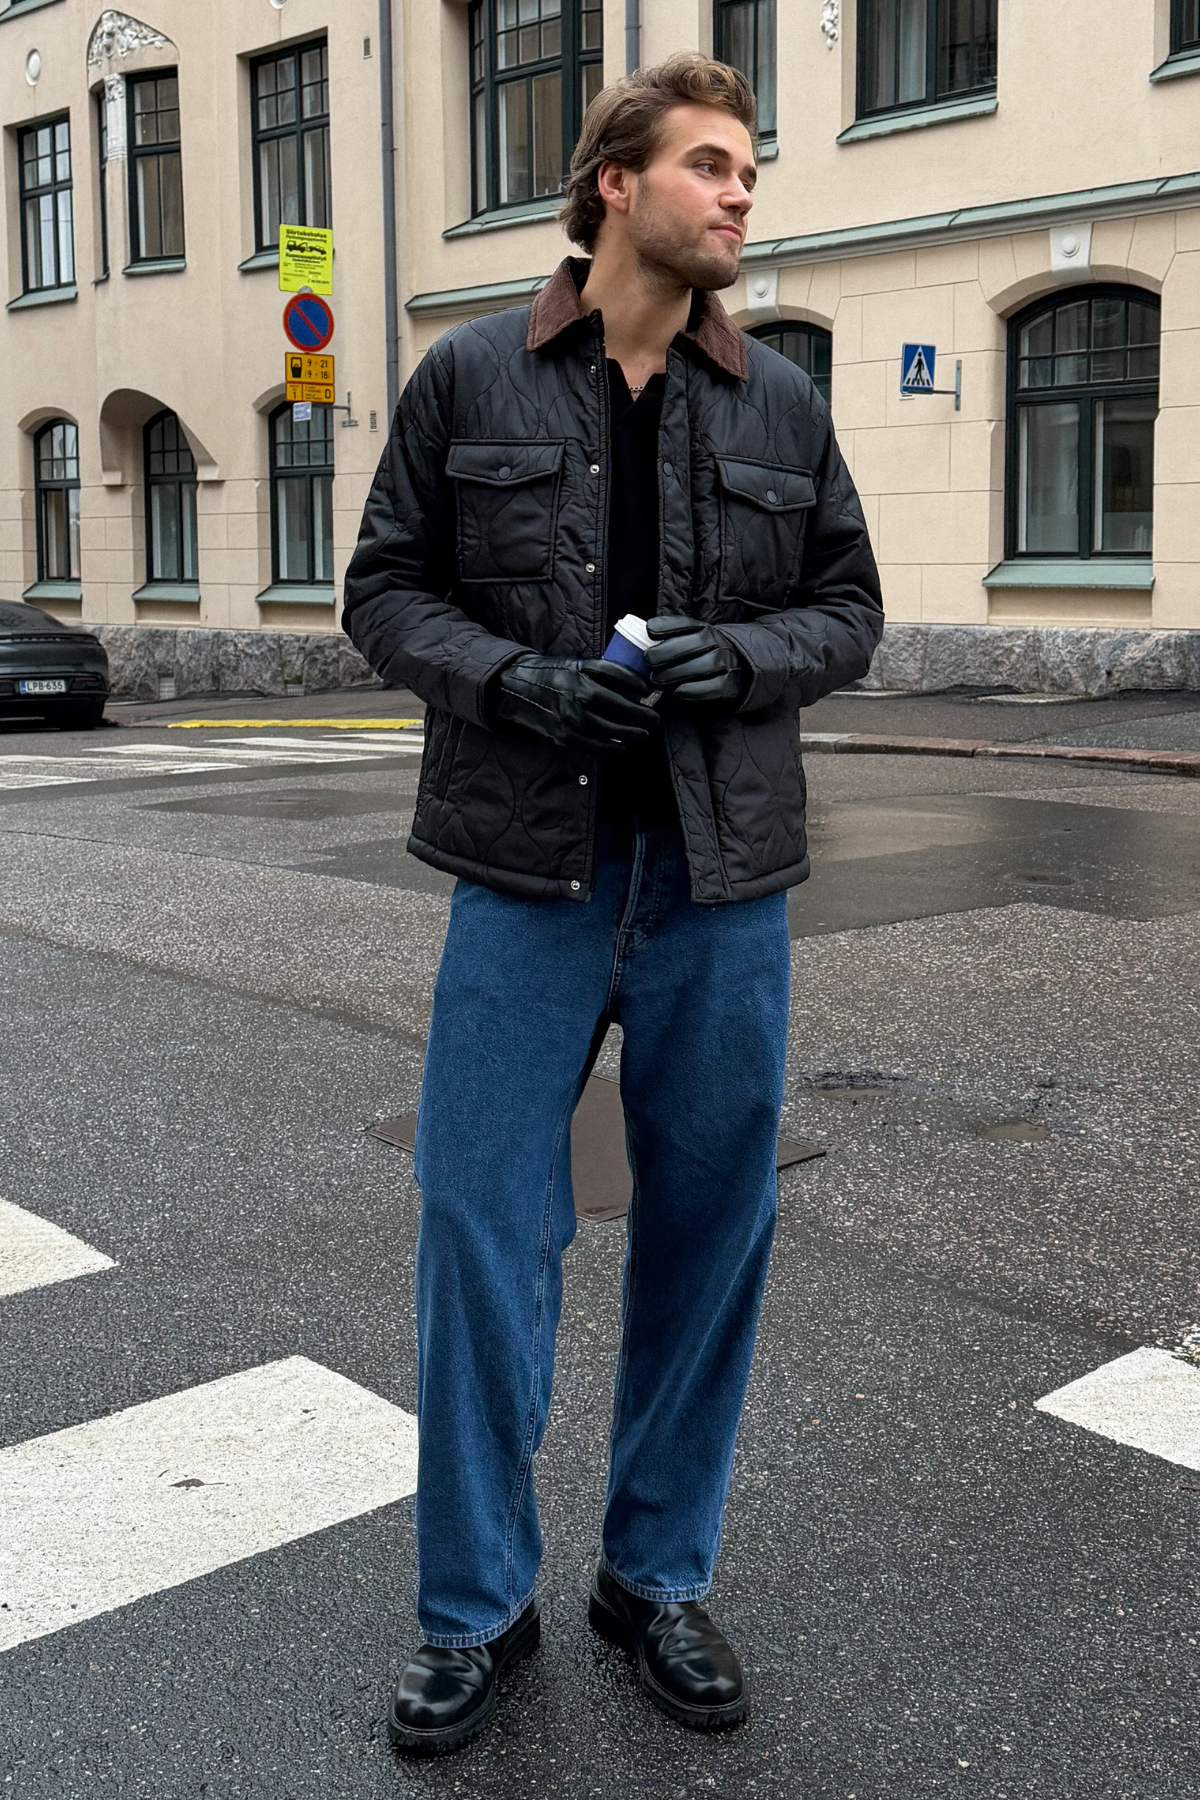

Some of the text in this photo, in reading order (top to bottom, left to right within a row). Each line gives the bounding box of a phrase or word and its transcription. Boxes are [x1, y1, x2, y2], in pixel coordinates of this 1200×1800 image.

[307, 358, 312, 367] 9
[320, 359, 328, 368] 21
[325, 388, 331, 399] D
[27, 681, 63, 691] LPB-635
